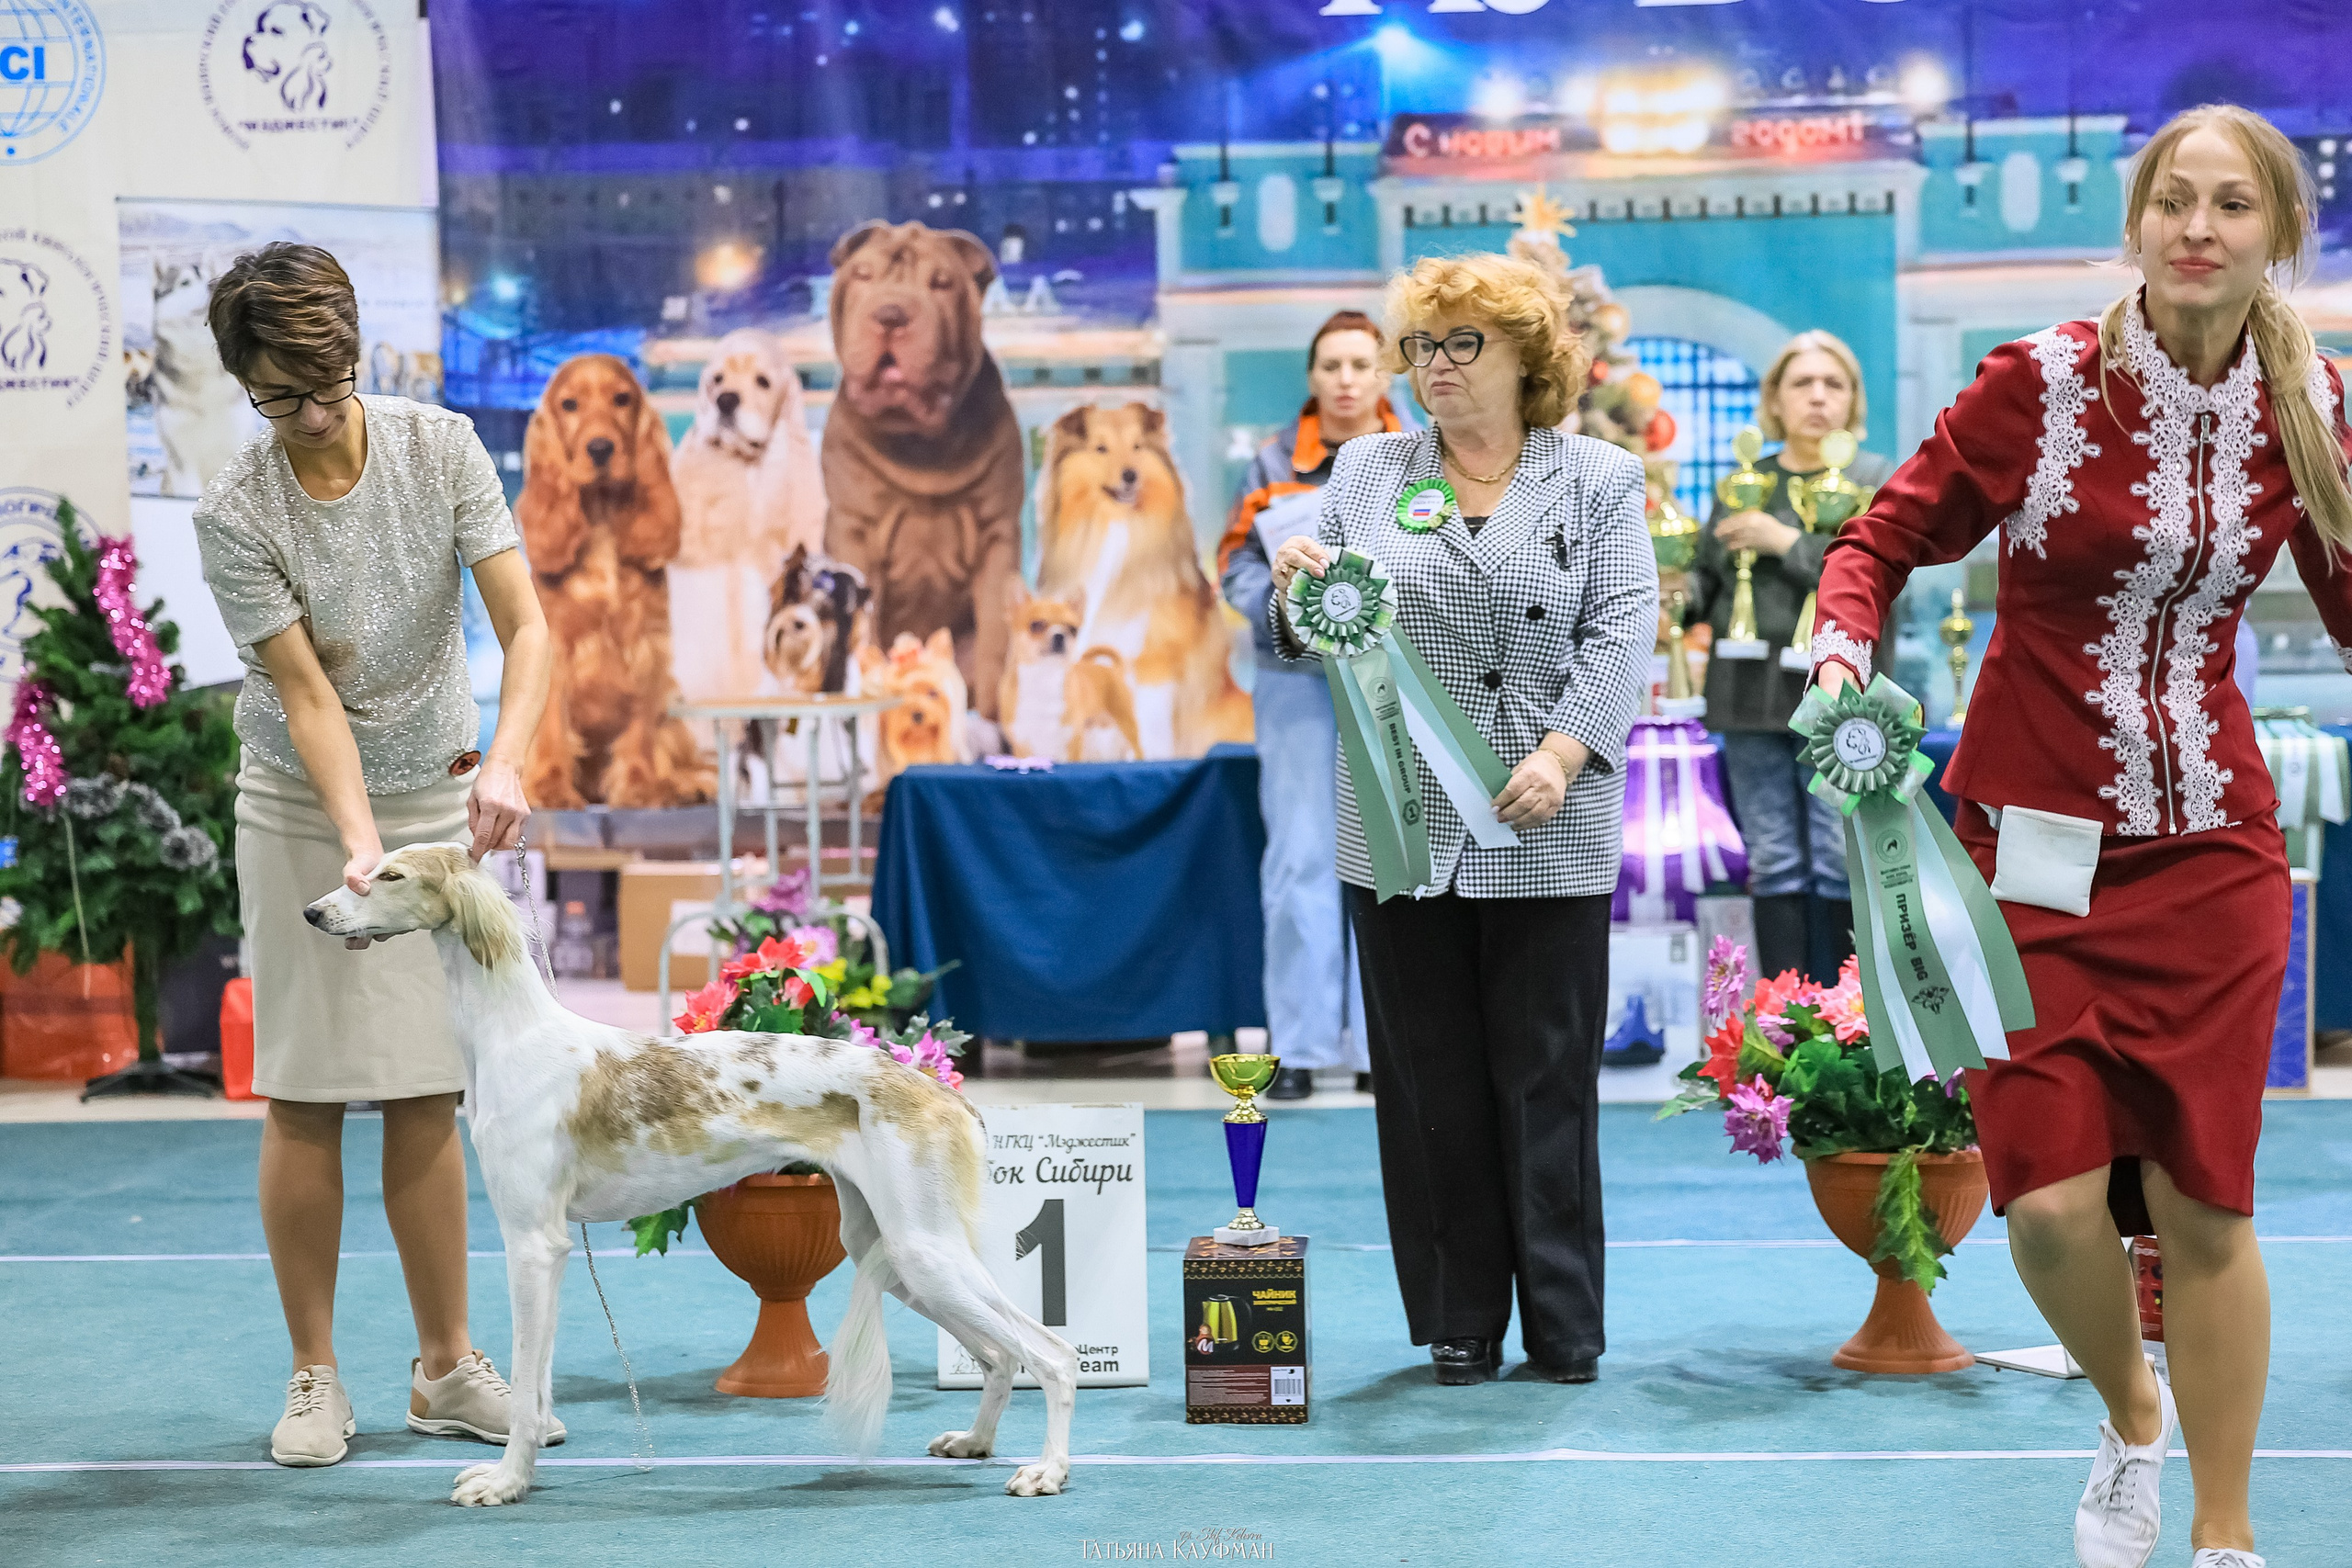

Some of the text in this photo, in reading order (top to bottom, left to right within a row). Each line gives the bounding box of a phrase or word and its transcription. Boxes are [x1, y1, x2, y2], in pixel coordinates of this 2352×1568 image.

[0, 46, 45, 81] CI
[1389, 723, 1411, 794] BEST IN GROUP
[1895, 893, 1917, 951] ПРИЗЁР
[1910, 955, 1928, 981] BIG
[1036, 1156, 1134, 1195] Сибири
[1015, 1199, 1067, 1326] 1
[1076, 1344, 1119, 1356] Центр
[1077, 1358, 1119, 1372] eam
